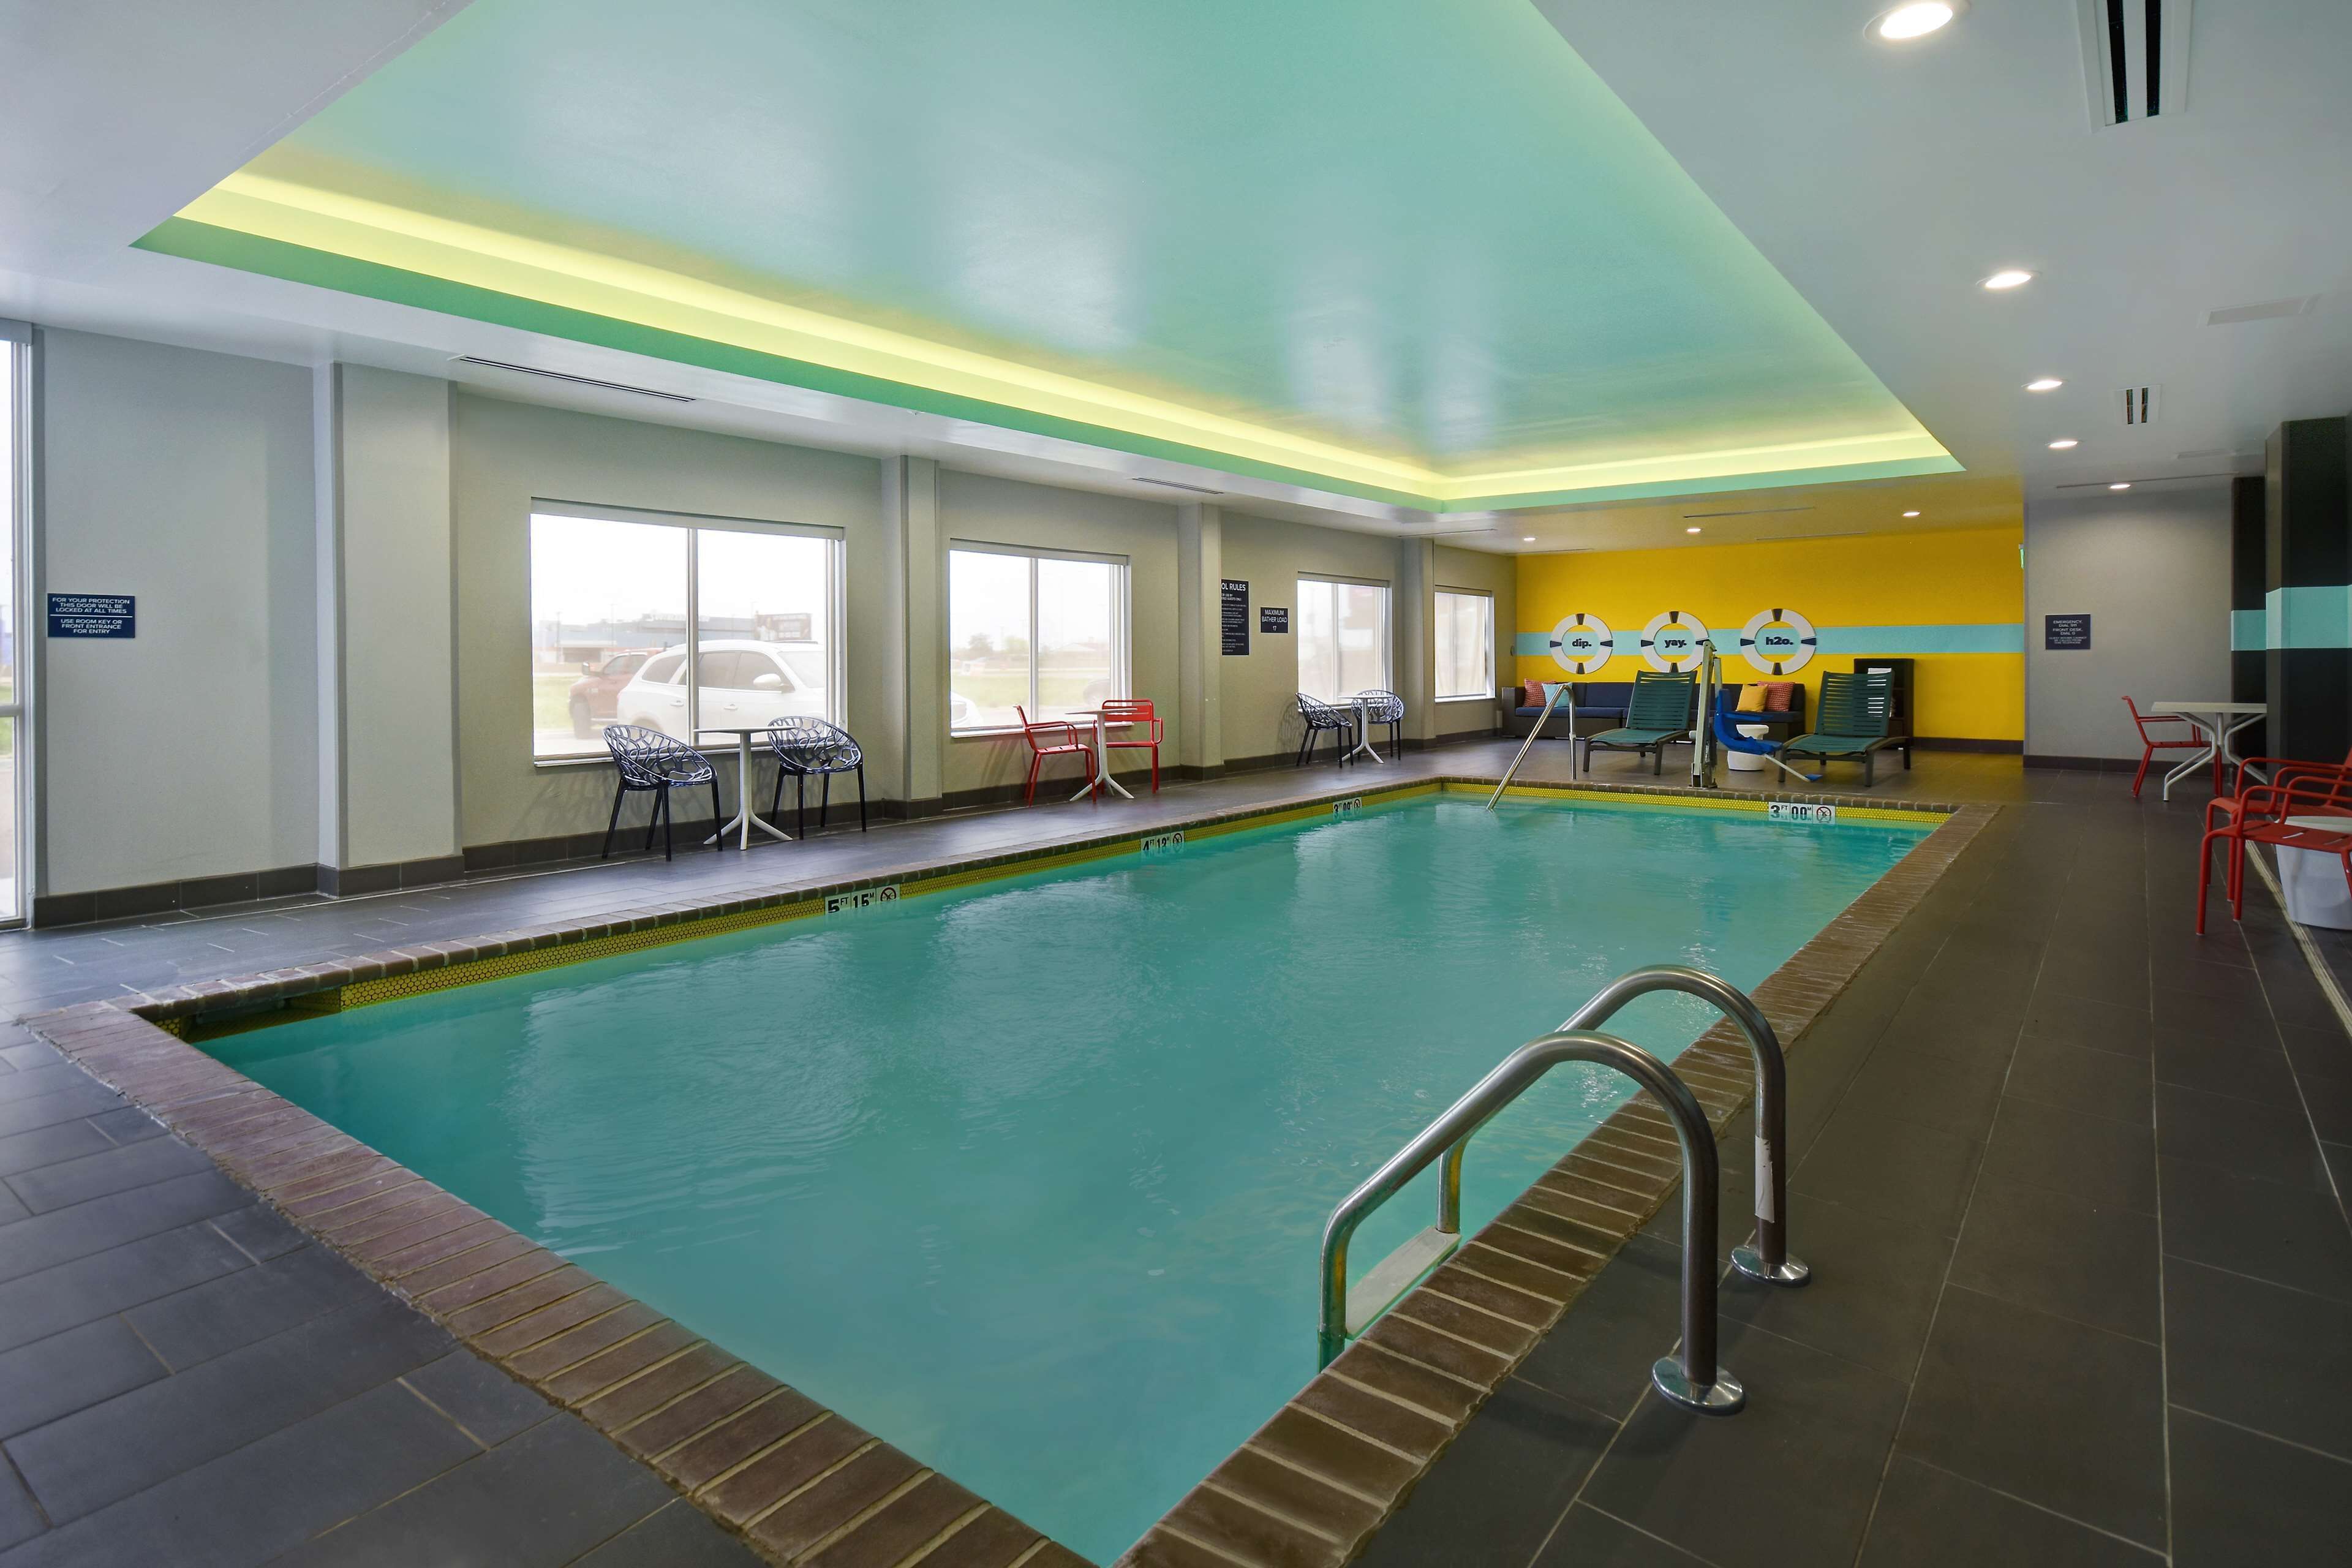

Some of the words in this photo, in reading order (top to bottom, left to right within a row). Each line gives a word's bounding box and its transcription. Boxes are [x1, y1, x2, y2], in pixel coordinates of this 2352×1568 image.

[1572, 638, 1592, 649] dip.
[1664, 639, 1687, 648] yay.
[1766, 636, 1793, 645] h2o.
